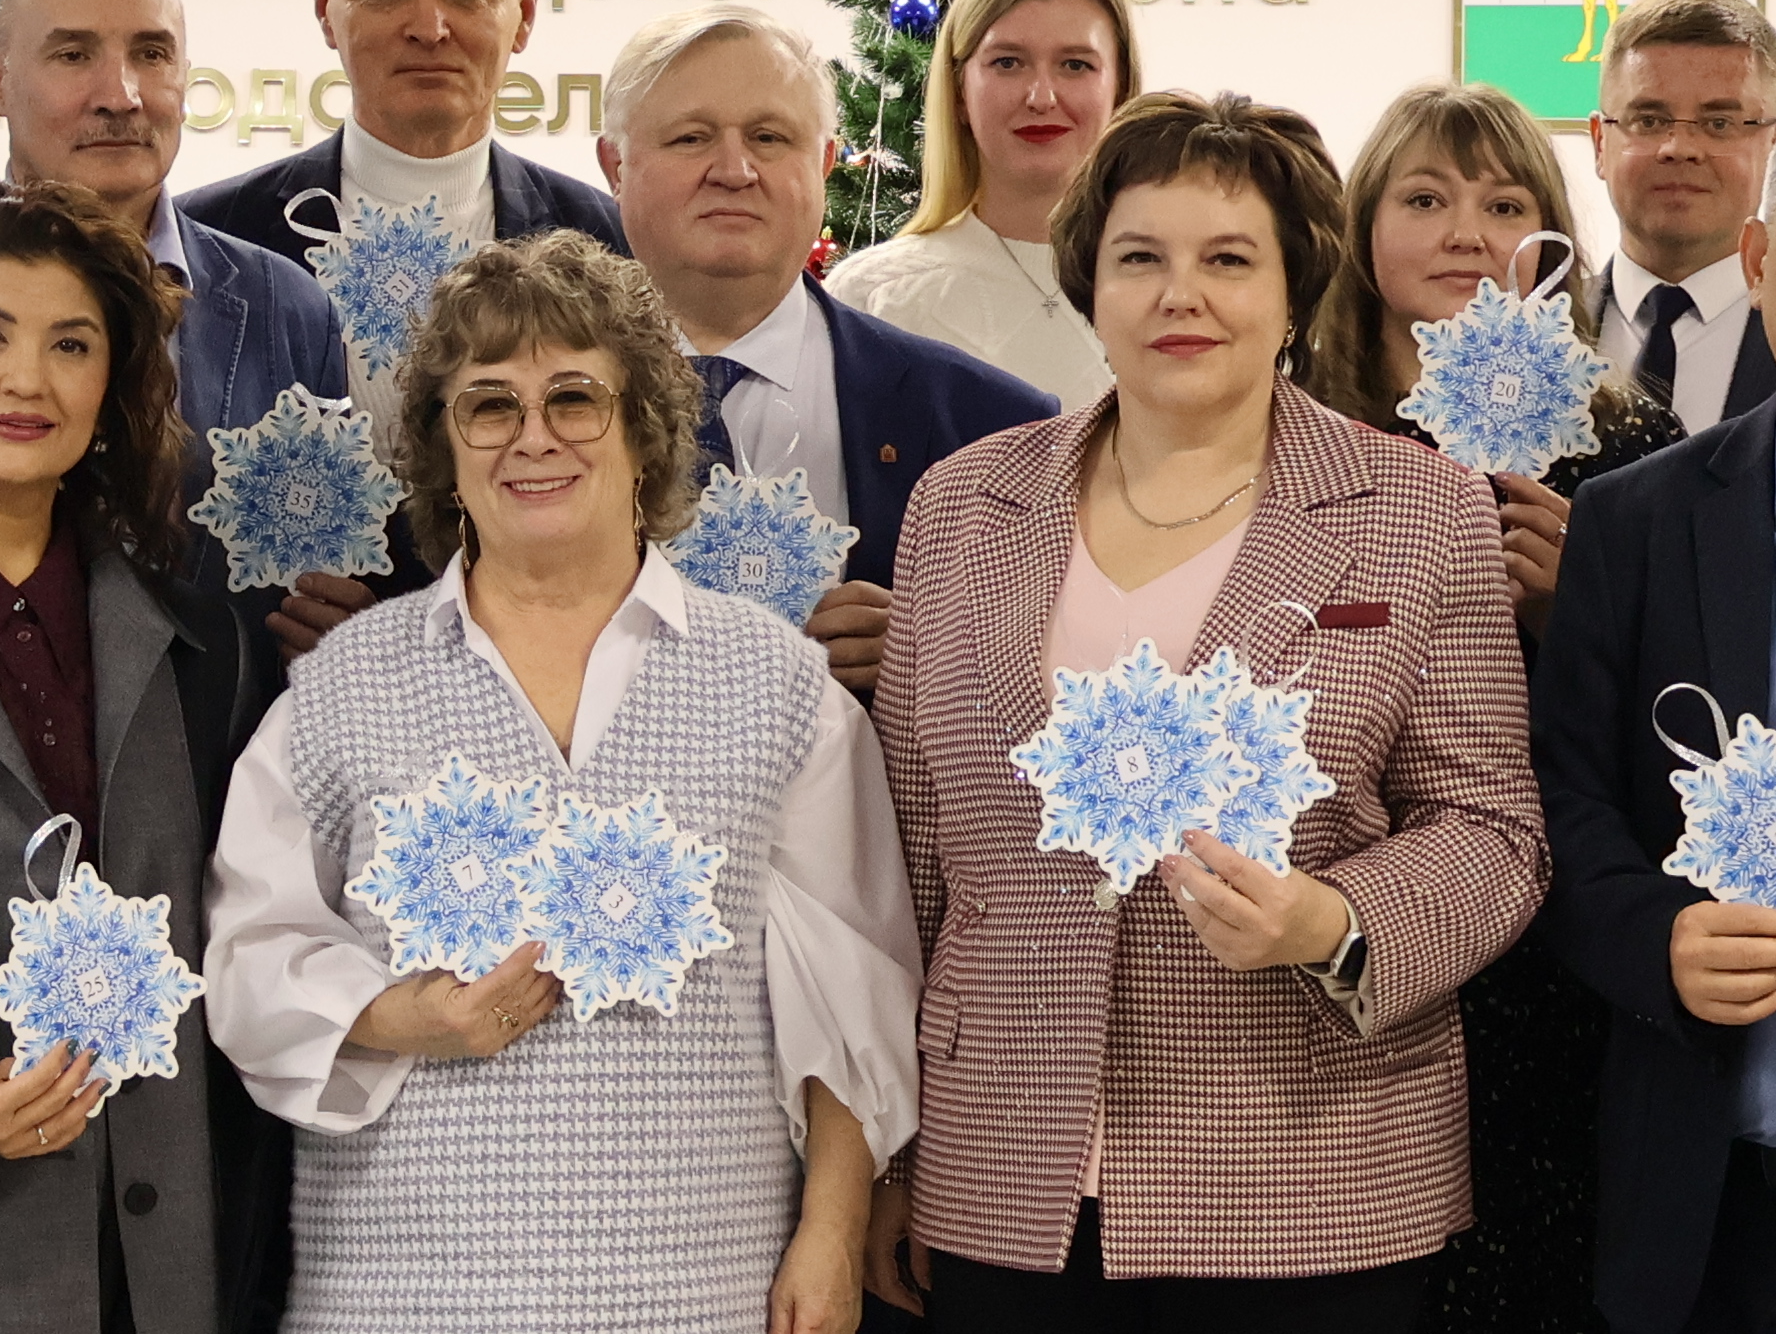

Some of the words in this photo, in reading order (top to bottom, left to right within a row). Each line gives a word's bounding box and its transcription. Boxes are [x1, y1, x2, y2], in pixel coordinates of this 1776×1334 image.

[391, 279, 409, 298] 31
[1494, 381, 1516, 399] 20
[290, 491, 312, 510] 35
[742, 562, 763, 578] 30
[1127, 755, 1139, 773] 8
[462, 864, 473, 880] 7
[608, 894, 623, 909] 3
[83, 975, 104, 998] 25
